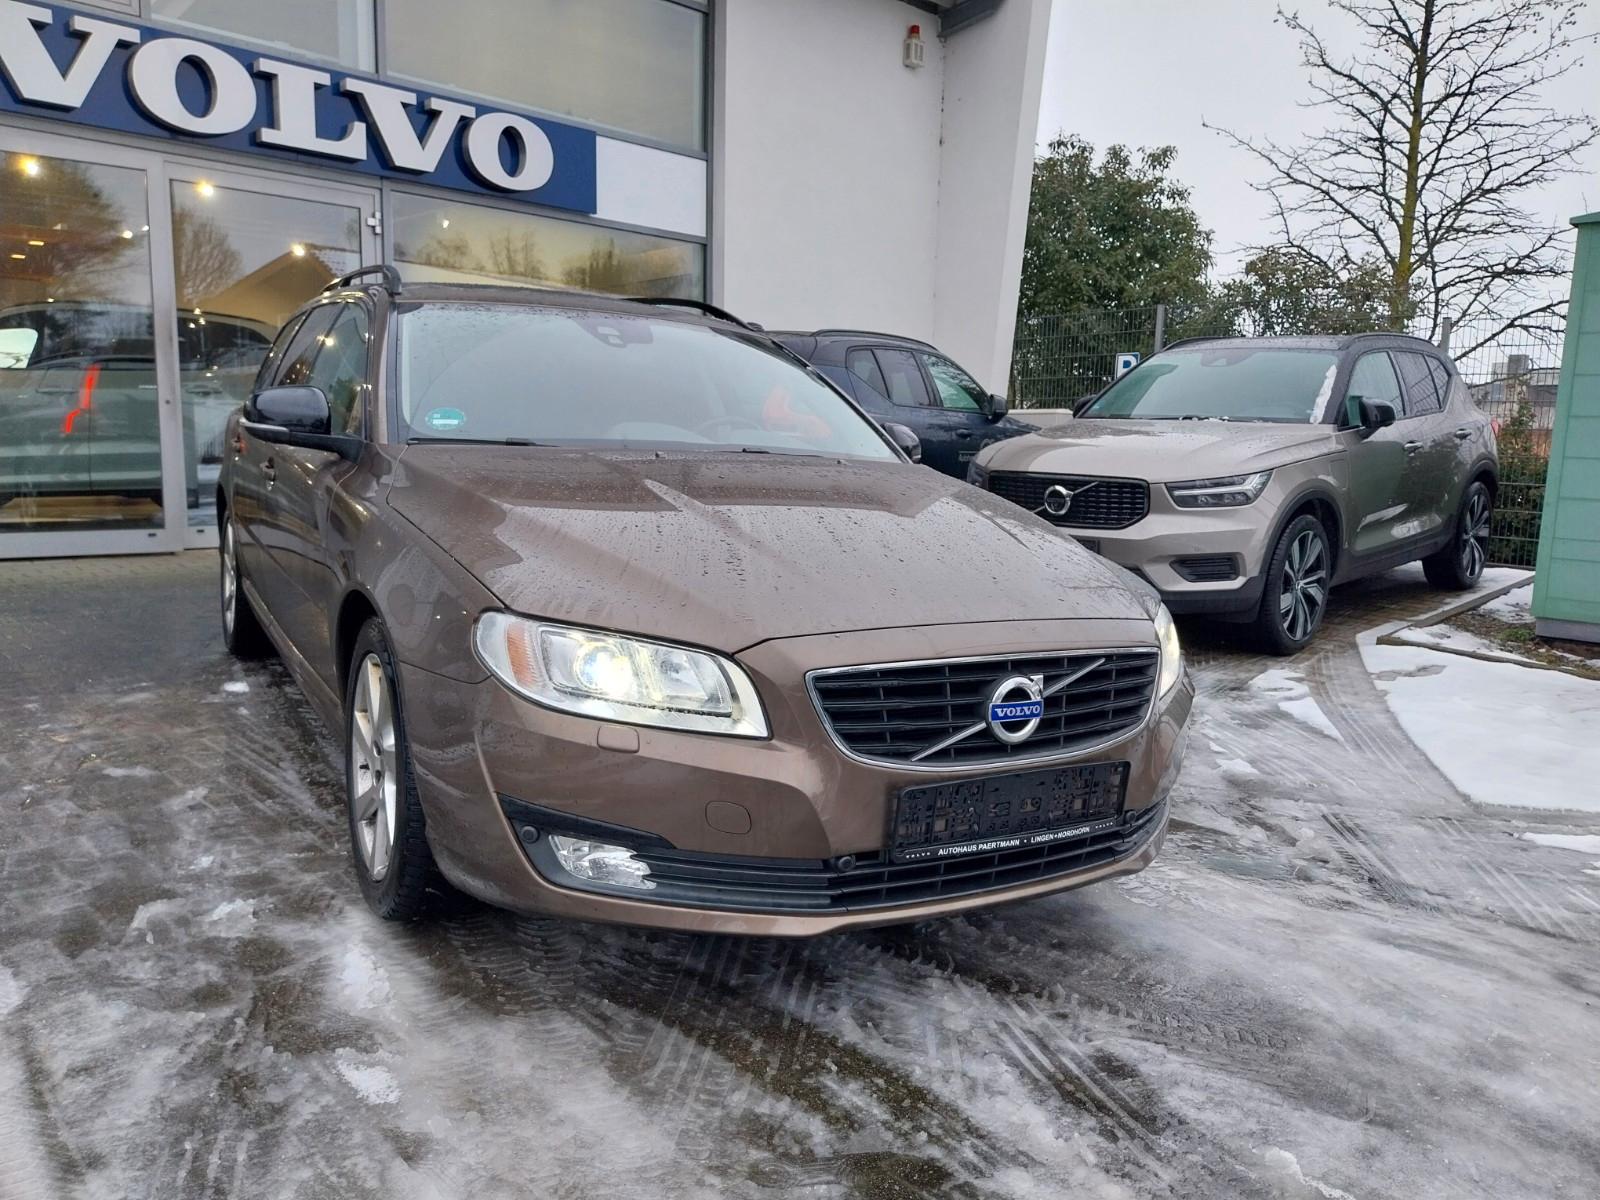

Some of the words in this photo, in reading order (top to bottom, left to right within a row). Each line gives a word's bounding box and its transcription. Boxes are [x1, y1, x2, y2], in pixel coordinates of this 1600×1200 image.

[0, 0, 555, 191] VOLVO
[994, 705, 1040, 717] VOLVO
[937, 844, 977, 856] AUTOHAUS
[978, 838, 1020, 851] PAERTMANN
